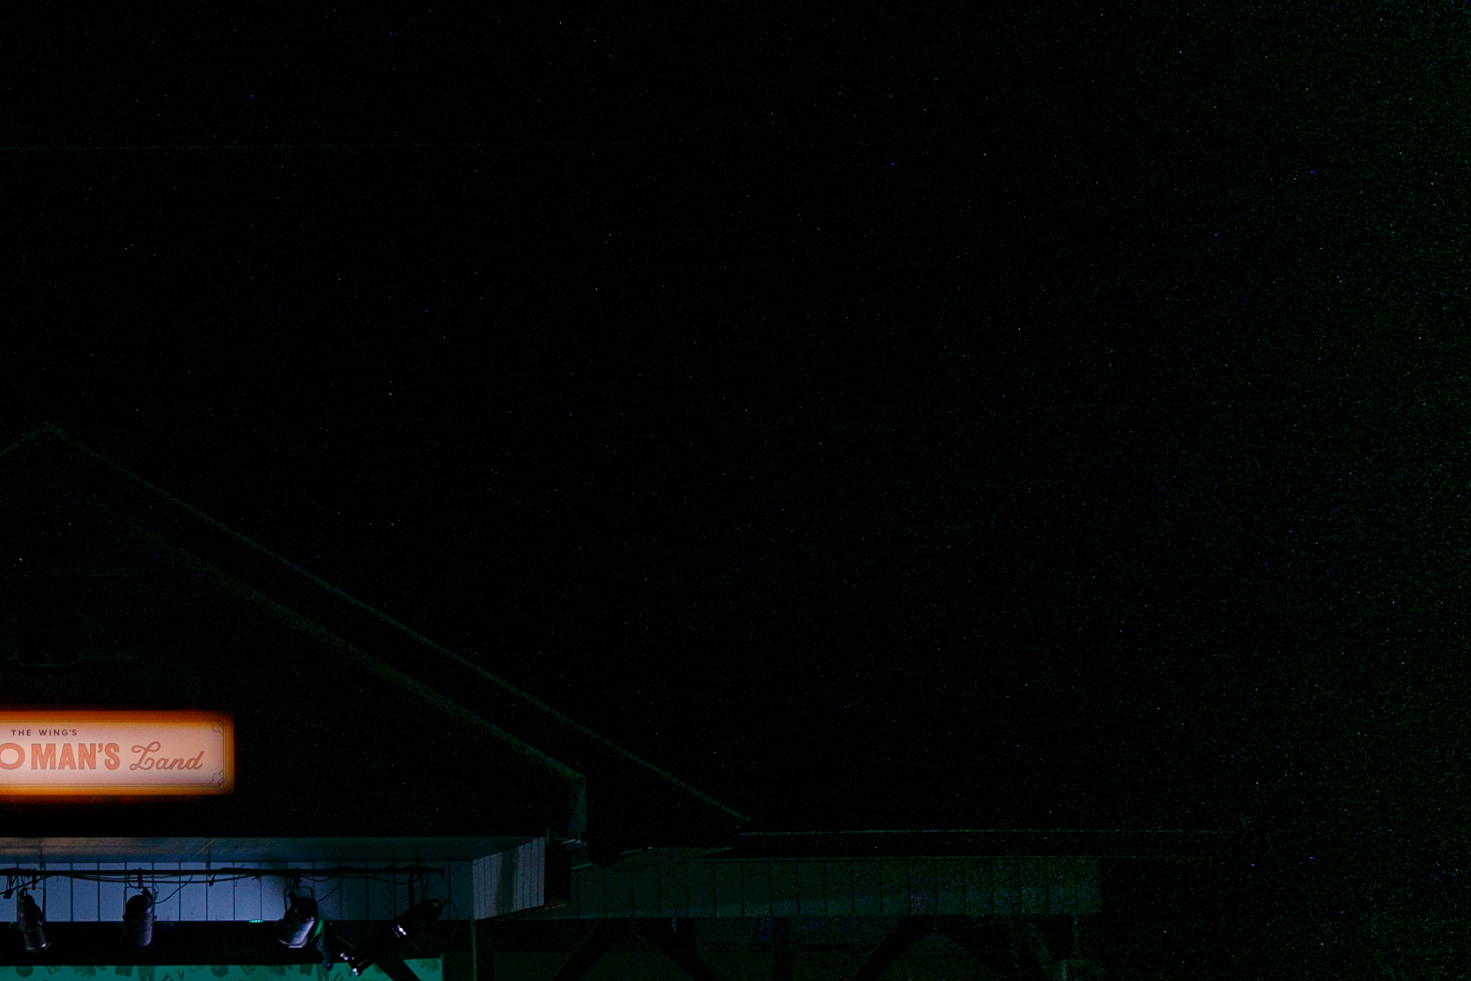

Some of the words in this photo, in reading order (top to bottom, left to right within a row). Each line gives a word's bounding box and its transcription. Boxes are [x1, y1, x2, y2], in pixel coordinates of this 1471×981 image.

[11, 729, 32, 737] THE
[39, 729, 78, 737] WING'S
[30, 743, 121, 770] MAN'S
[129, 741, 205, 772] Land
